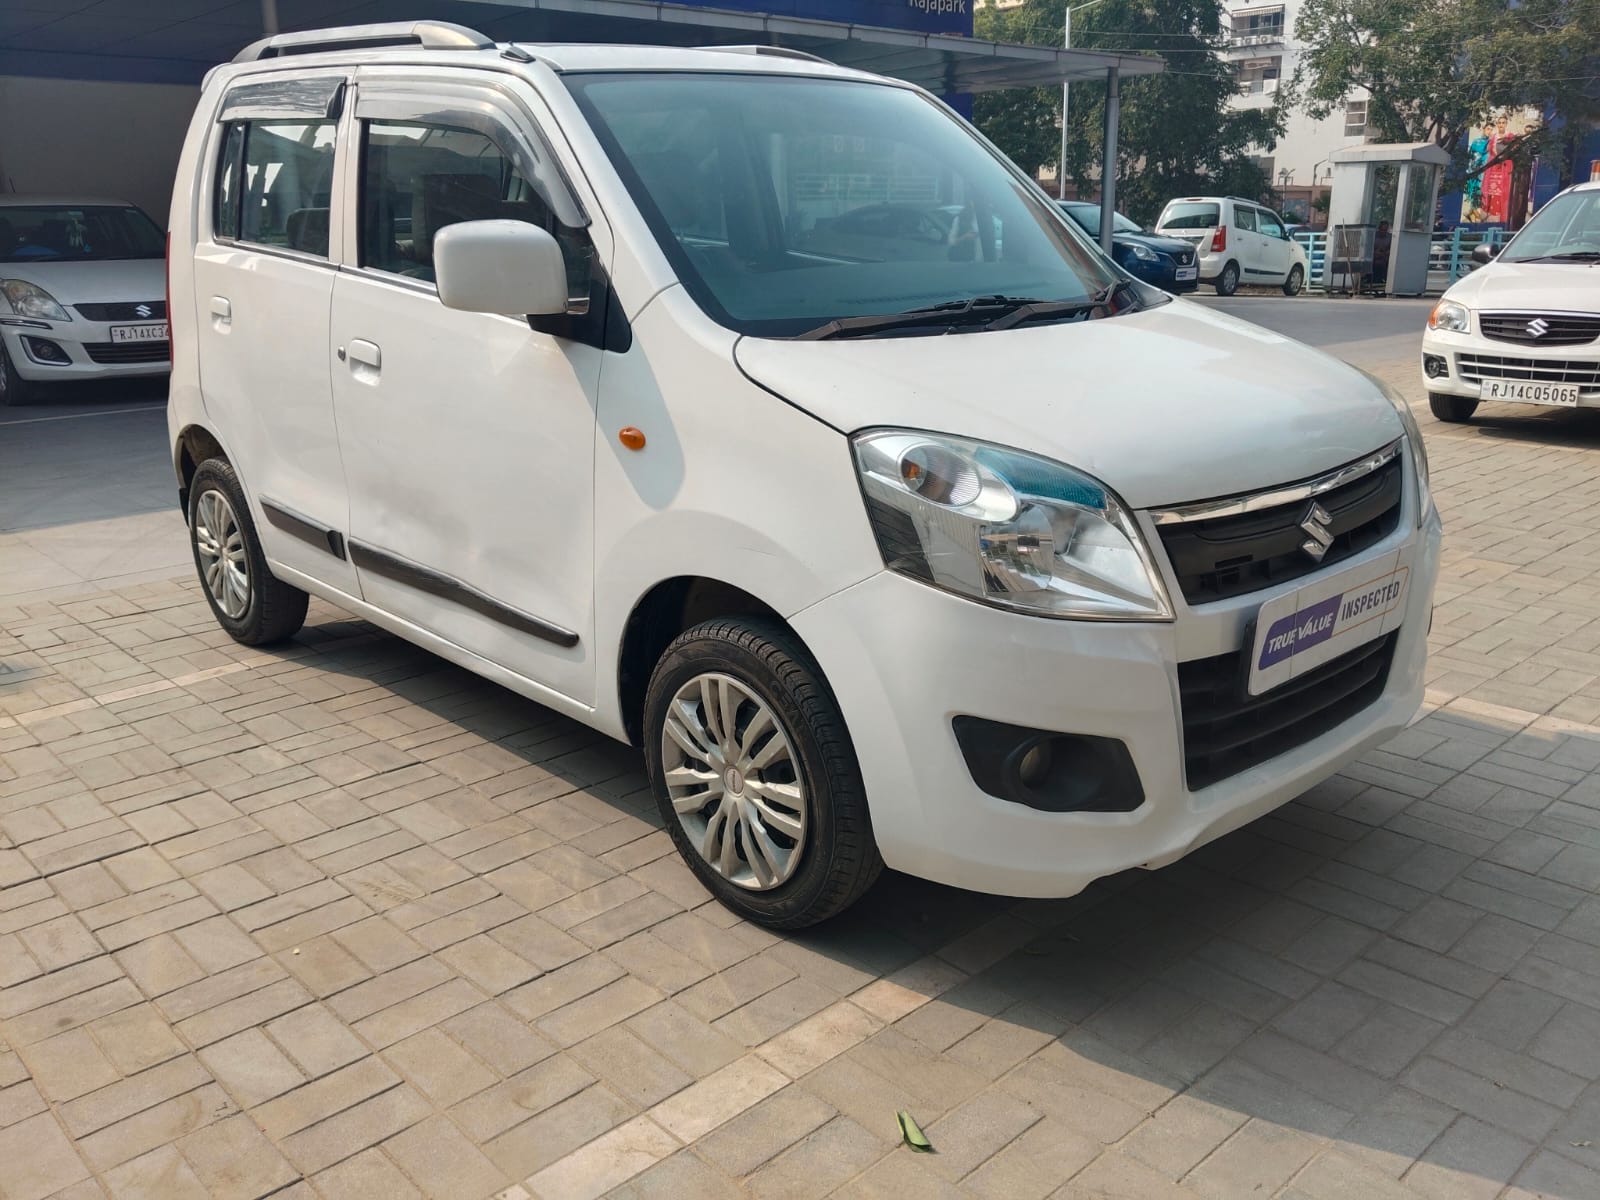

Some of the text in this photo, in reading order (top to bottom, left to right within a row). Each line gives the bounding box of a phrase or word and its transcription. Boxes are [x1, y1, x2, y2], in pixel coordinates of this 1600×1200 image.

[1268, 581, 1400, 654] TRUE VALUE INSPECTED
